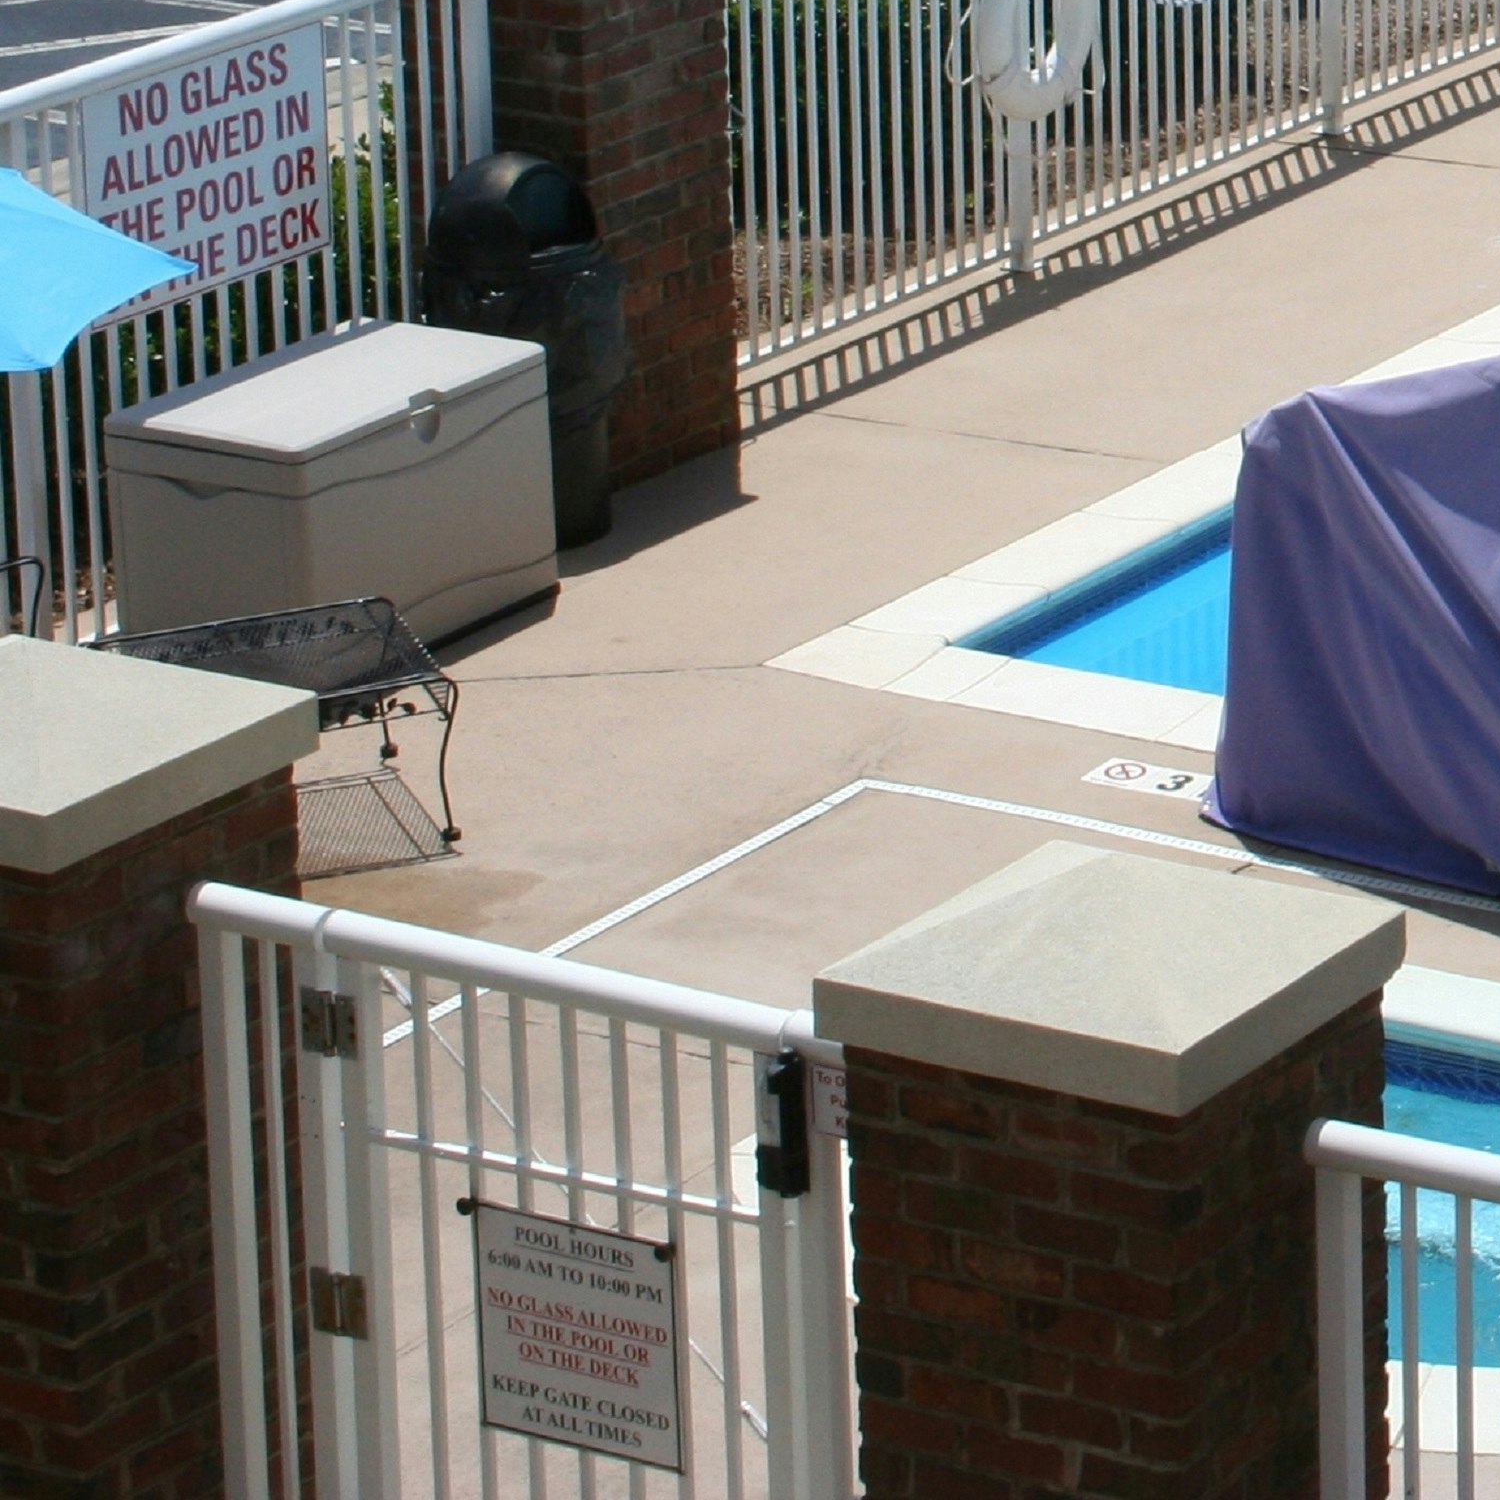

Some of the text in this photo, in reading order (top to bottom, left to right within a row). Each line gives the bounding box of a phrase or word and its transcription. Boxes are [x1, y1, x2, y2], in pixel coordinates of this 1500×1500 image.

[118, 42, 289, 137] NO GLASS
[101, 91, 310, 201] ALLOWED IN
[177, 166, 264, 231] POOL
[273, 145, 317, 197] OR
[236, 198, 321, 267] DECK
[1156, 774, 1195, 792] 3
[815, 1070, 832, 1085] To
[514, 1226, 635, 1269] POOL HOURS
[488, 1250, 663, 1304] 6:00 AM TO 10:00 PM
[487, 1286, 668, 1344] NO GLASS ALLOWED
[507, 1315, 649, 1364] IN THE POOL OR
[519, 1342, 639, 1386] ON THE DECK
[492, 1374, 670, 1431] KEEP GATE CLOSED
[521, 1405, 643, 1448] AT ALL TIMES
